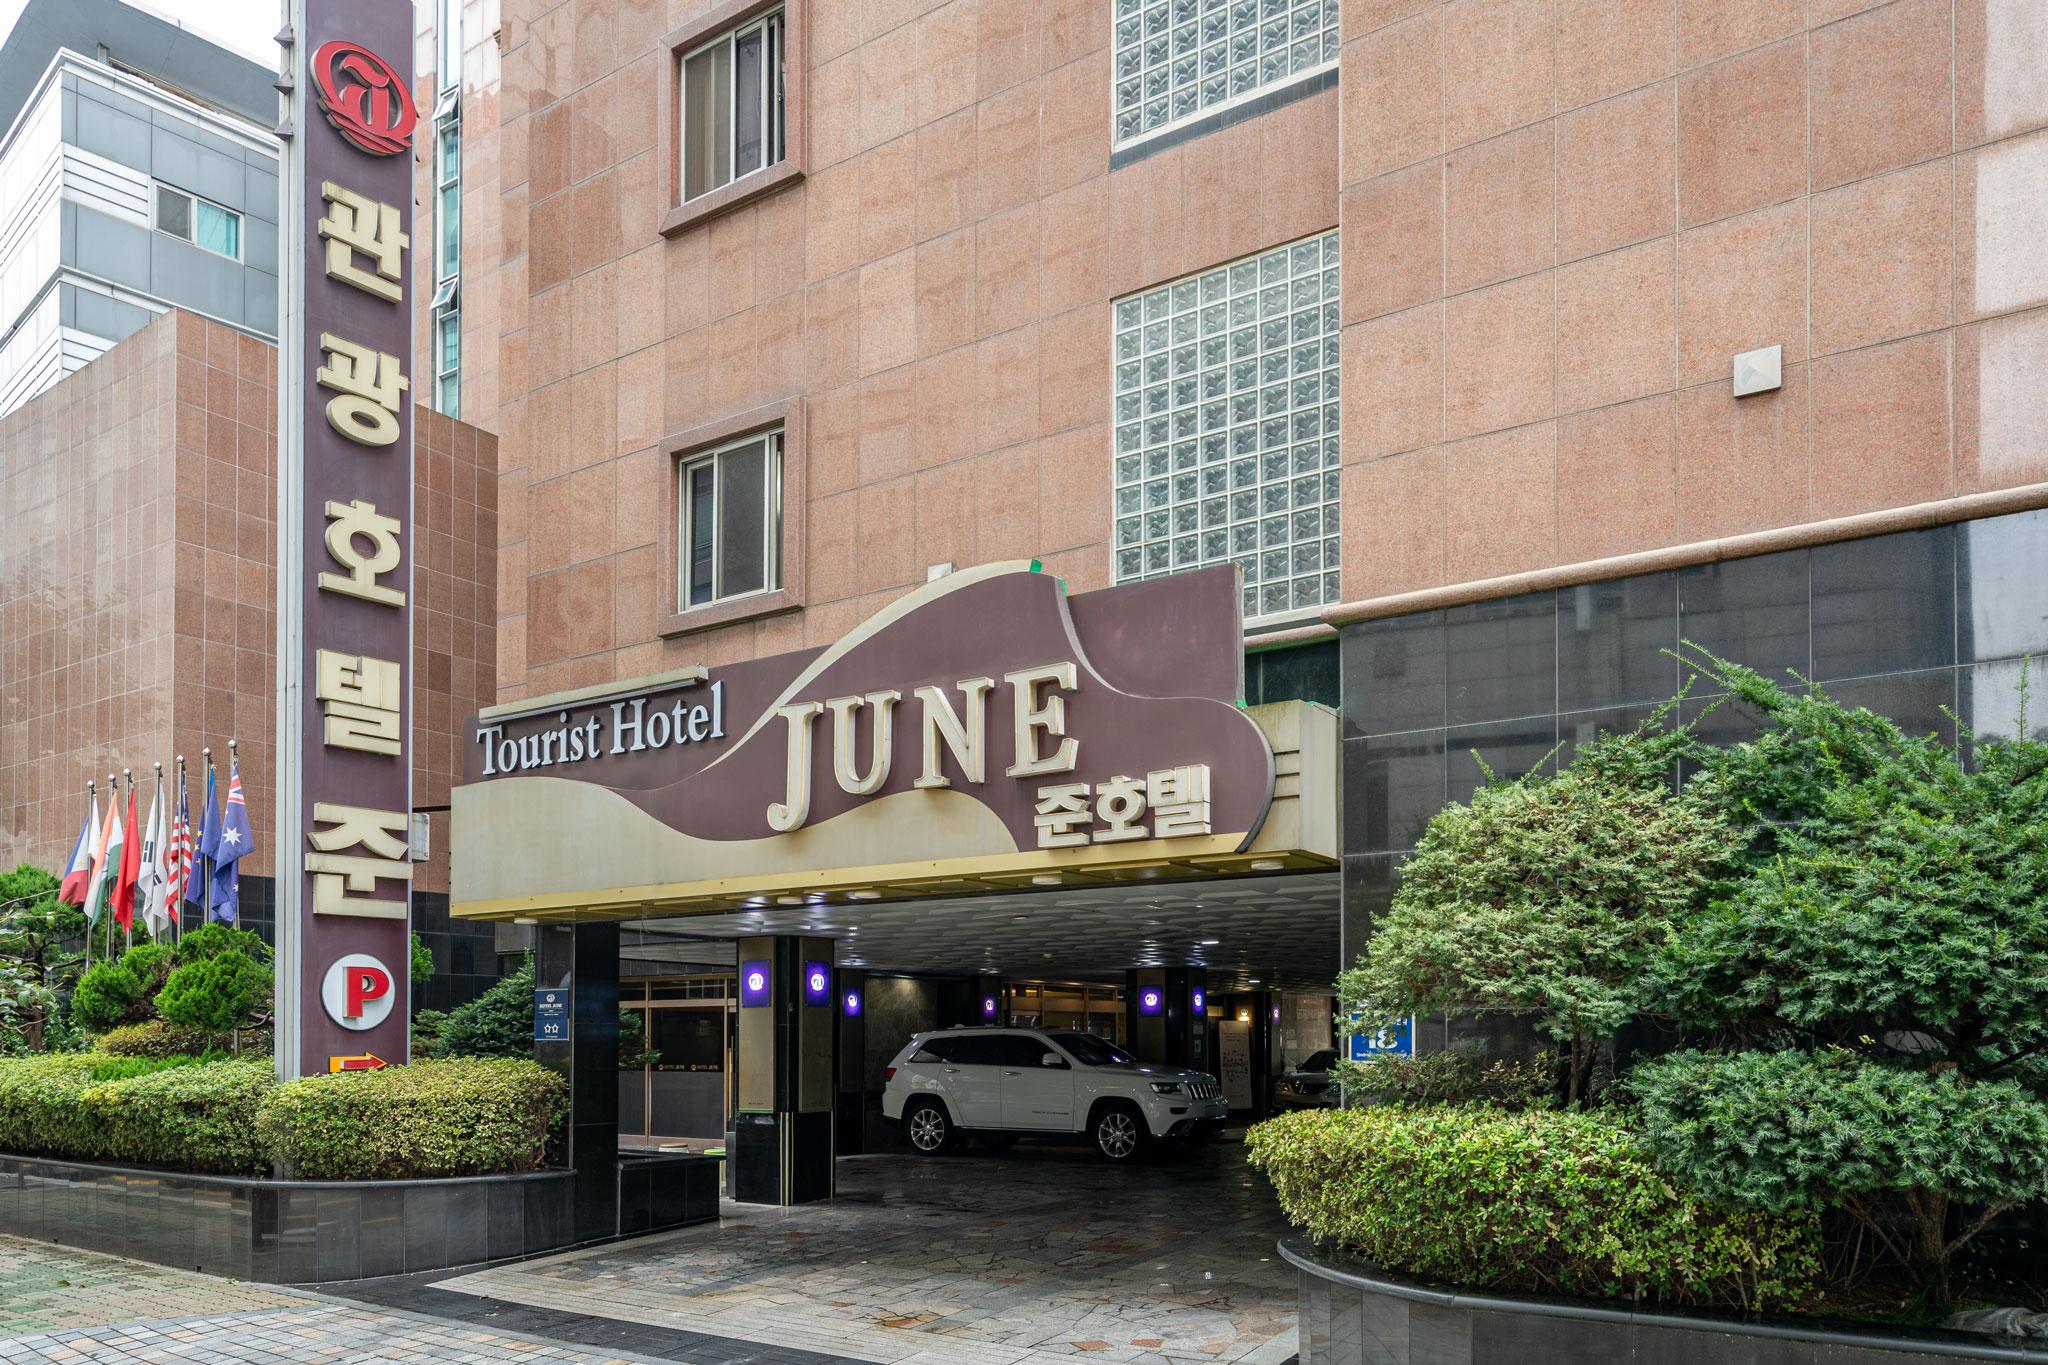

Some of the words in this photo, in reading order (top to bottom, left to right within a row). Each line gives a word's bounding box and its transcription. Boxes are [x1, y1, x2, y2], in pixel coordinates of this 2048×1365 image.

[476, 711, 600, 775] Tourist
[610, 680, 725, 755] Hotel
[766, 661, 1078, 833] JUNE
[1034, 763, 1212, 848] 준호텔
[342, 966, 390, 1018] P
